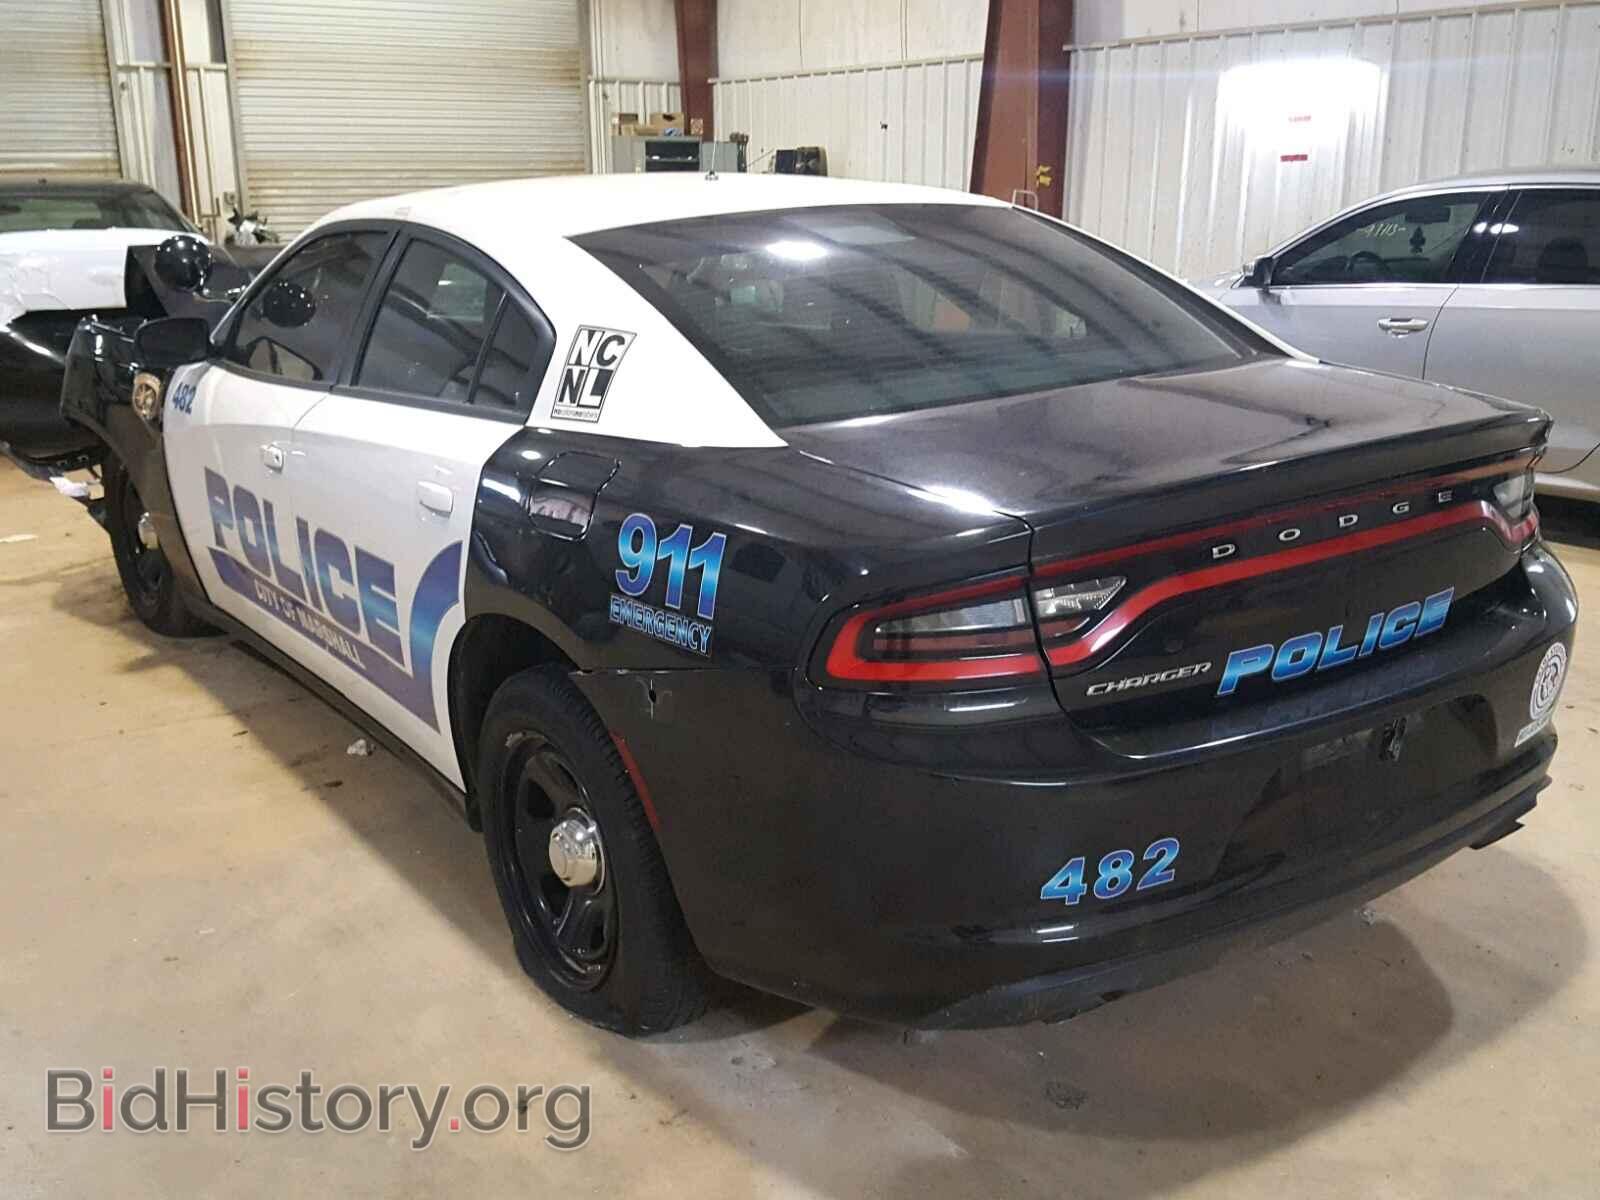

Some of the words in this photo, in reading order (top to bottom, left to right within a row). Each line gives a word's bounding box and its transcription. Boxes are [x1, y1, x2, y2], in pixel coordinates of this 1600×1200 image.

[172, 383, 196, 414] 482
[1211, 488, 1453, 560] DODGE
[204, 466, 406, 667] POLICE
[615, 512, 727, 620] 911
[609, 594, 712, 656] EMERGENCY
[1216, 586, 1455, 697] POLICE
[1086, 661, 1212, 696] CHARGER
[1040, 837, 1180, 906] 482
